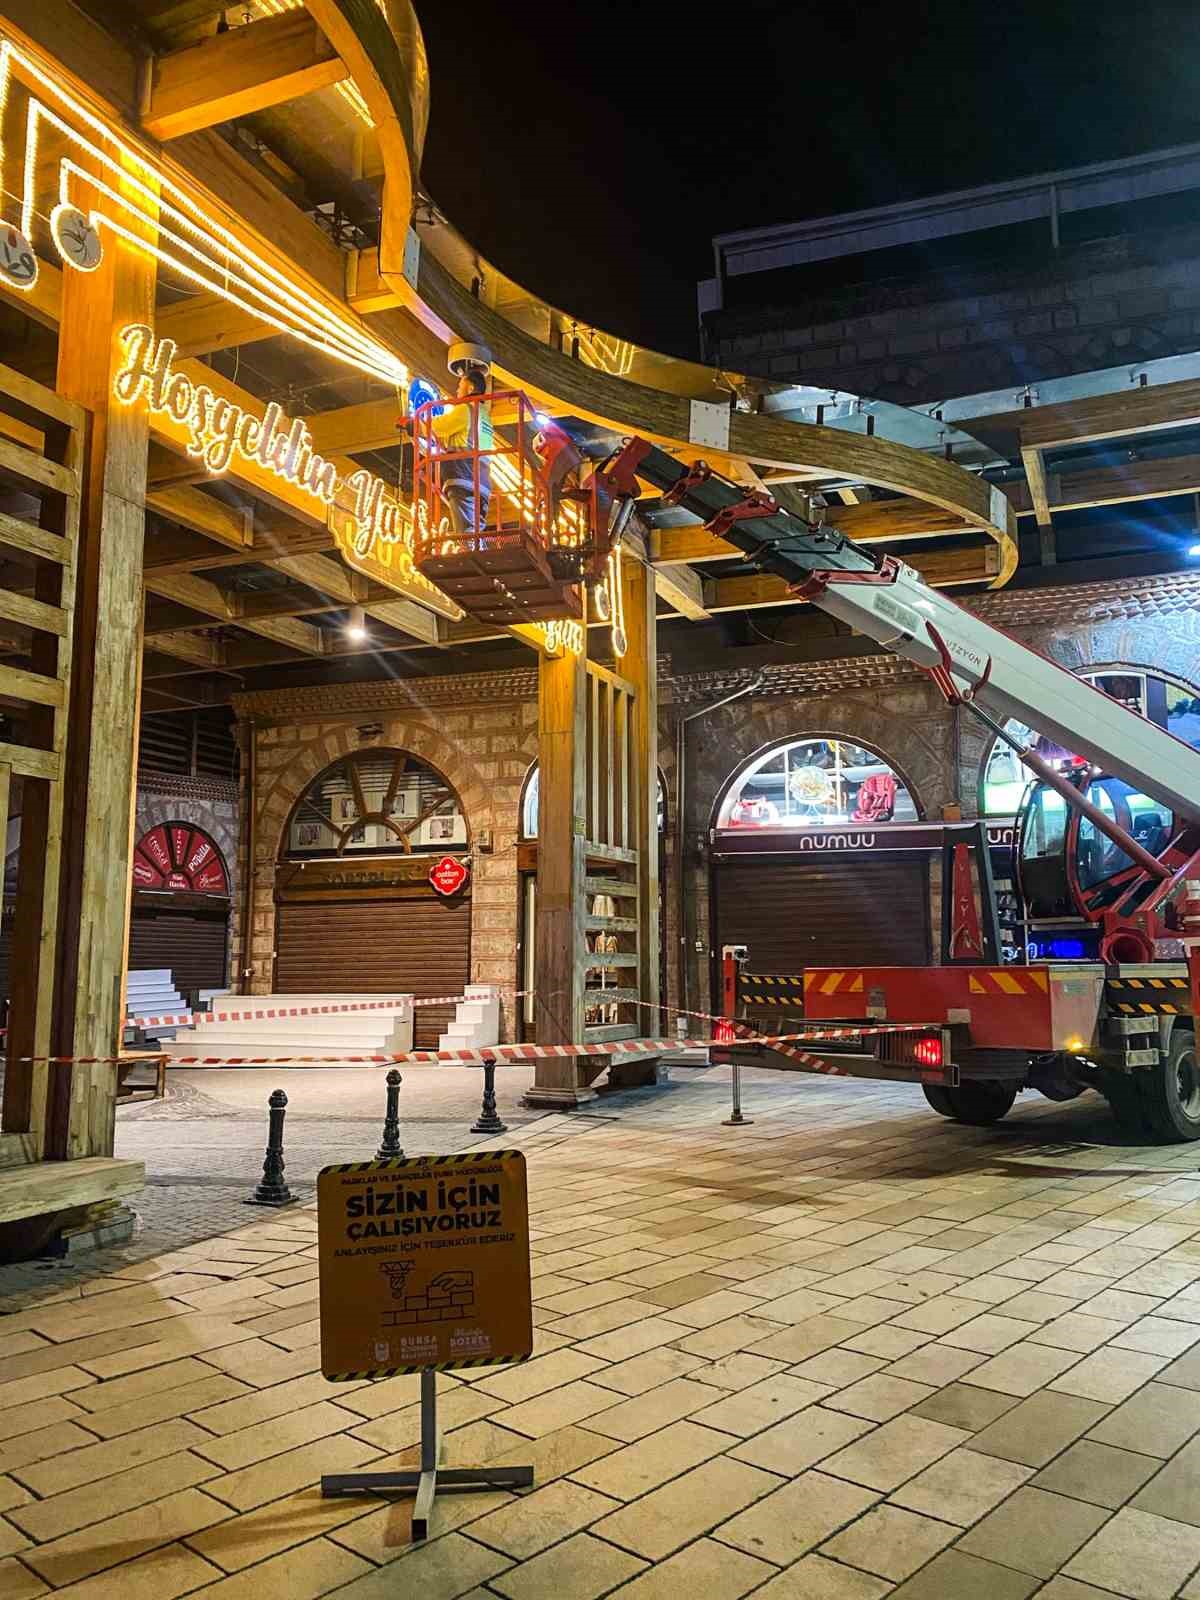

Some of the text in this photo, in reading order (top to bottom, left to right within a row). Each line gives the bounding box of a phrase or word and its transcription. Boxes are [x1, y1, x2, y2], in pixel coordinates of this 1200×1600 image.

[800, 832, 876, 850] numuu
[346, 1177, 500, 1218] SİZİN İÇİN
[346, 1210, 502, 1242] ÇALIŞIYORUZ
